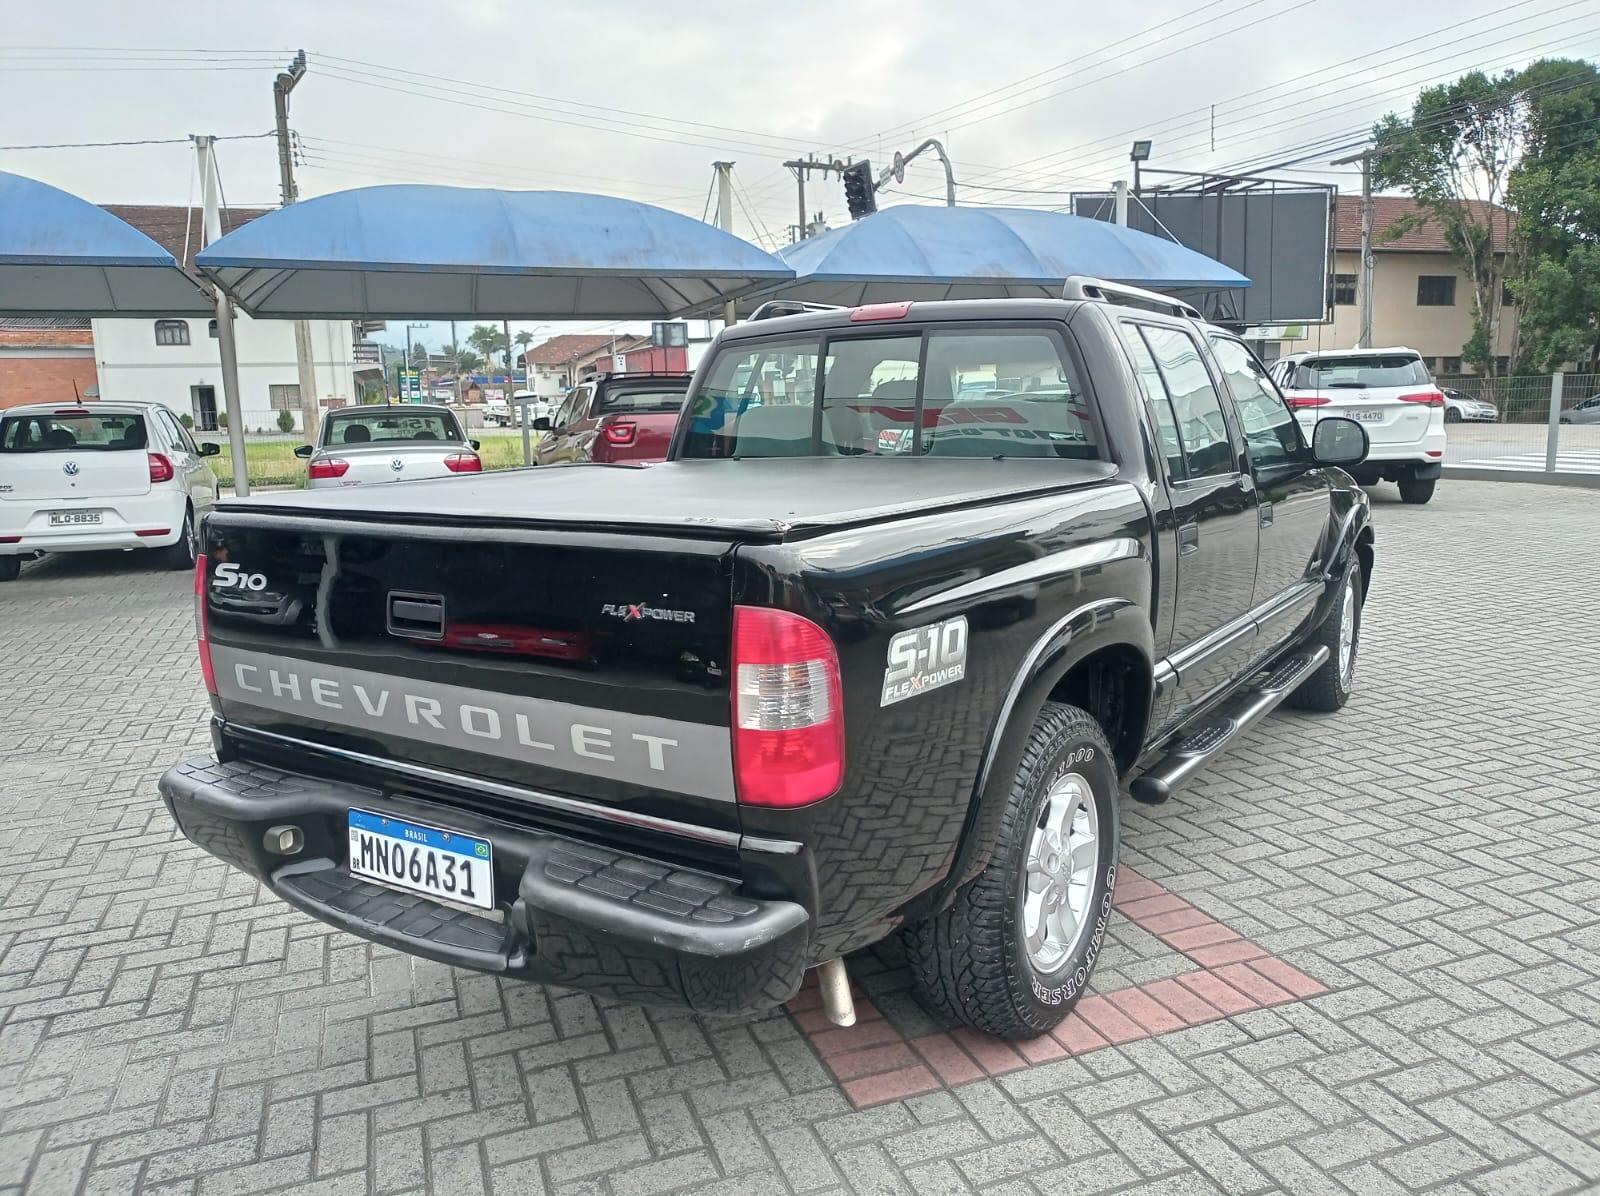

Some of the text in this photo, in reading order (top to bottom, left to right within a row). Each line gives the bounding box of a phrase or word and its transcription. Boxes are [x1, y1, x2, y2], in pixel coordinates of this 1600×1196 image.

[212, 562, 267, 591] S10
[601, 602, 695, 622] FLEXPOWER
[886, 619, 967, 684] S-10
[884, 664, 963, 701] FLEXPOWER
[234, 663, 678, 771] CHEVROLET
[404, 828, 428, 843] BRASIL
[352, 857, 360, 870] BR
[1032, 865, 1116, 1005] COMFORSER
